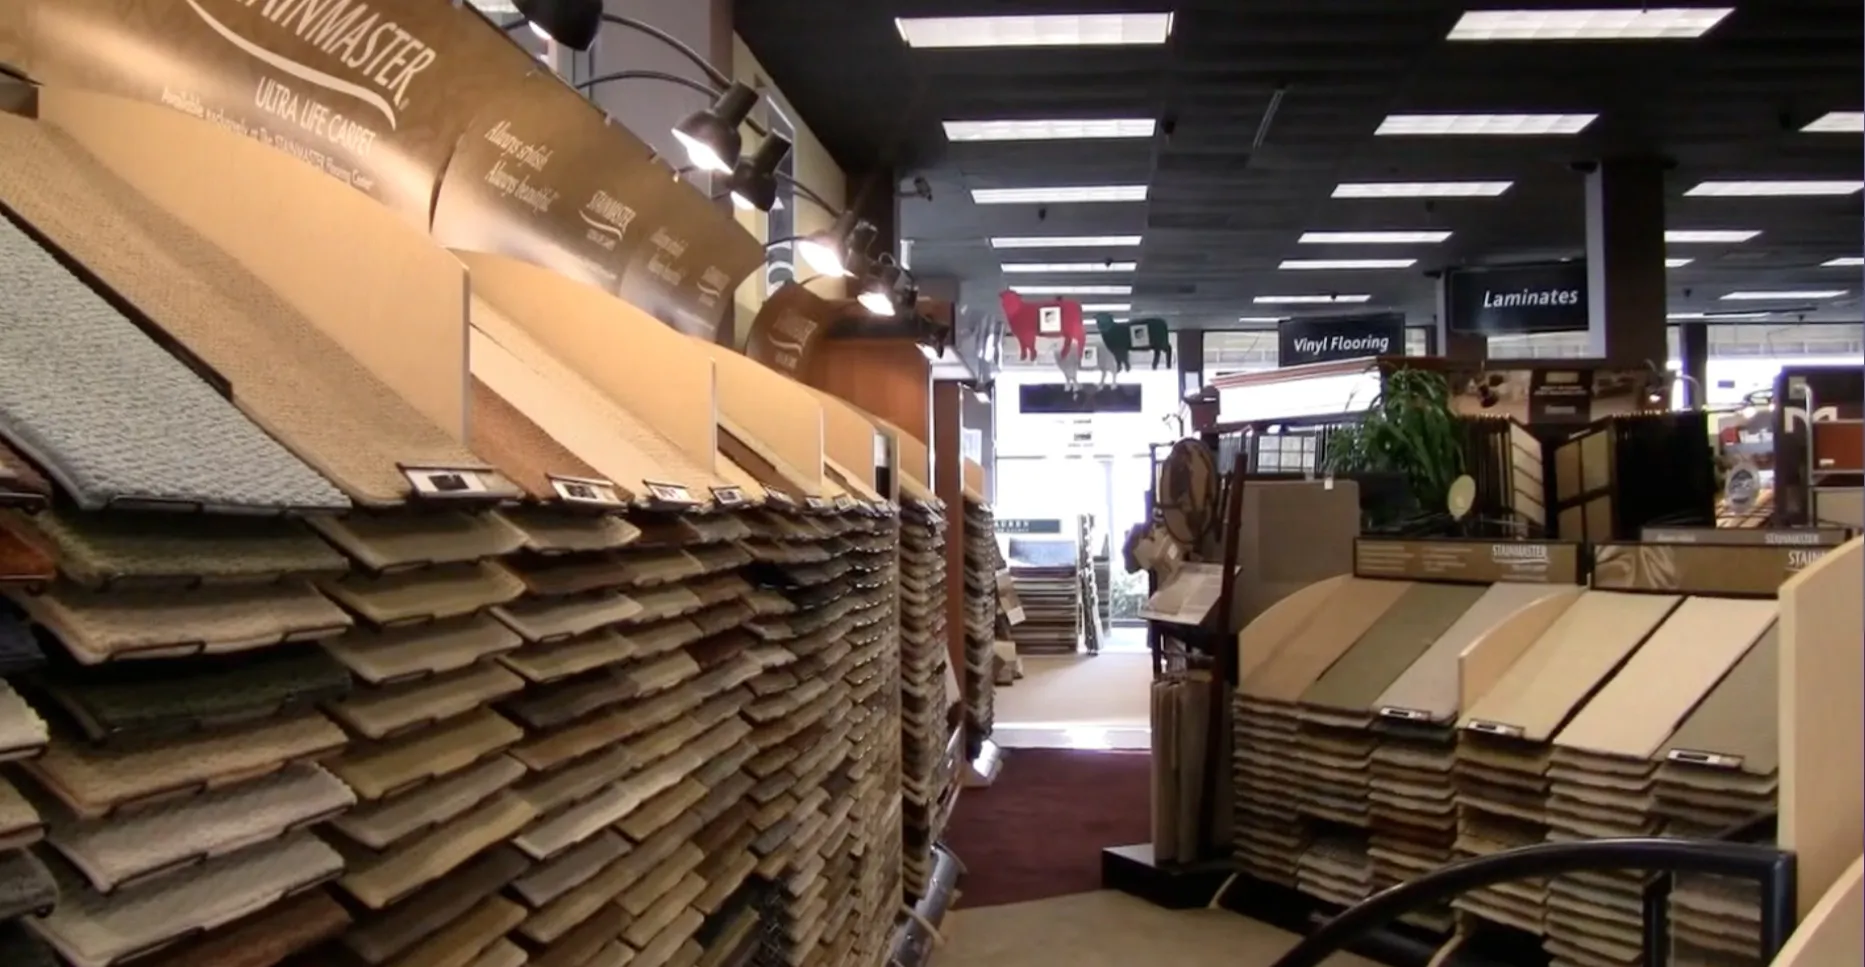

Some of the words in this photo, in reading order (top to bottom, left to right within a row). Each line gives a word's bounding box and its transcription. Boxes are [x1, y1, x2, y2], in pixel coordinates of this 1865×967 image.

[254, 76, 296, 122] ULTRA
[300, 98, 329, 135] LIFE
[327, 114, 376, 156] CARPET
[484, 120, 523, 157] Always
[484, 160, 519, 197] Always
[1484, 288, 1579, 308] Laminates
[1294, 336, 1328, 355] Vinyl
[1331, 334, 1390, 353] Flooring
